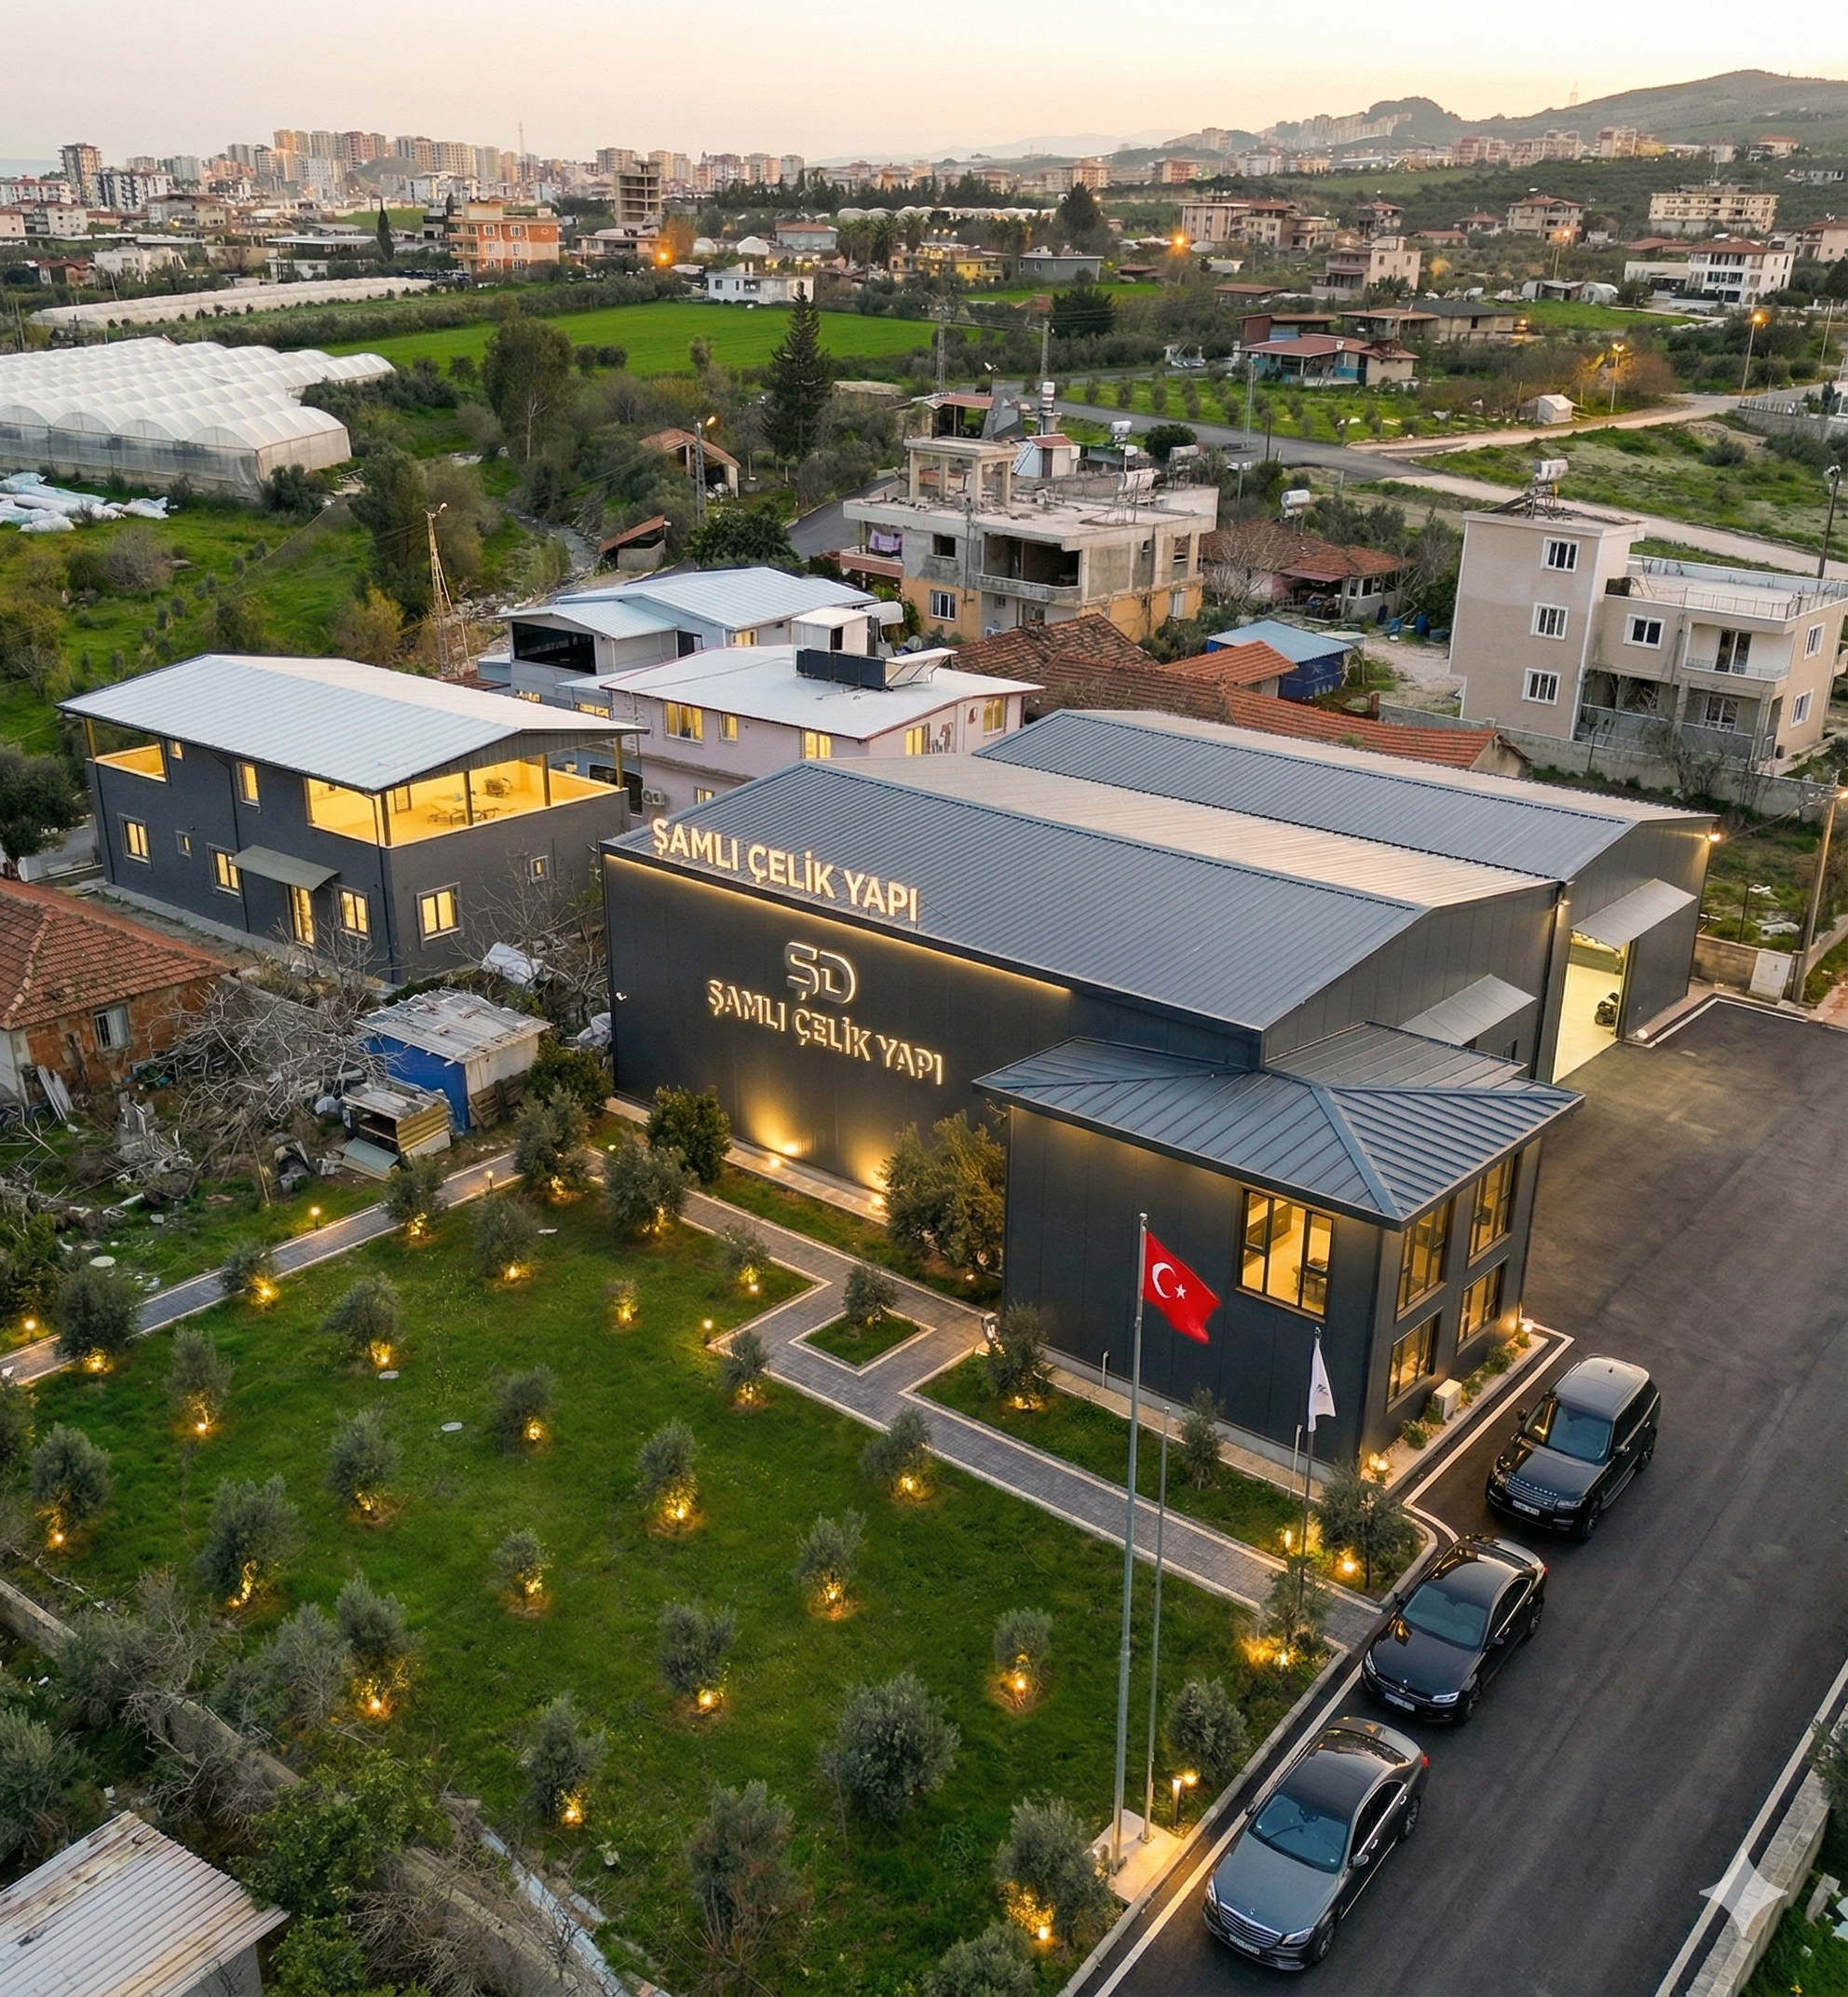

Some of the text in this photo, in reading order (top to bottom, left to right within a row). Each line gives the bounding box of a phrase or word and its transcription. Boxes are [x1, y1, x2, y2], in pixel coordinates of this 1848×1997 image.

[652, 818, 918, 922] ŞAMLI ÇELİK YAPI
[706, 979, 944, 1085] ŞAMLI ÇELİK YAPI
